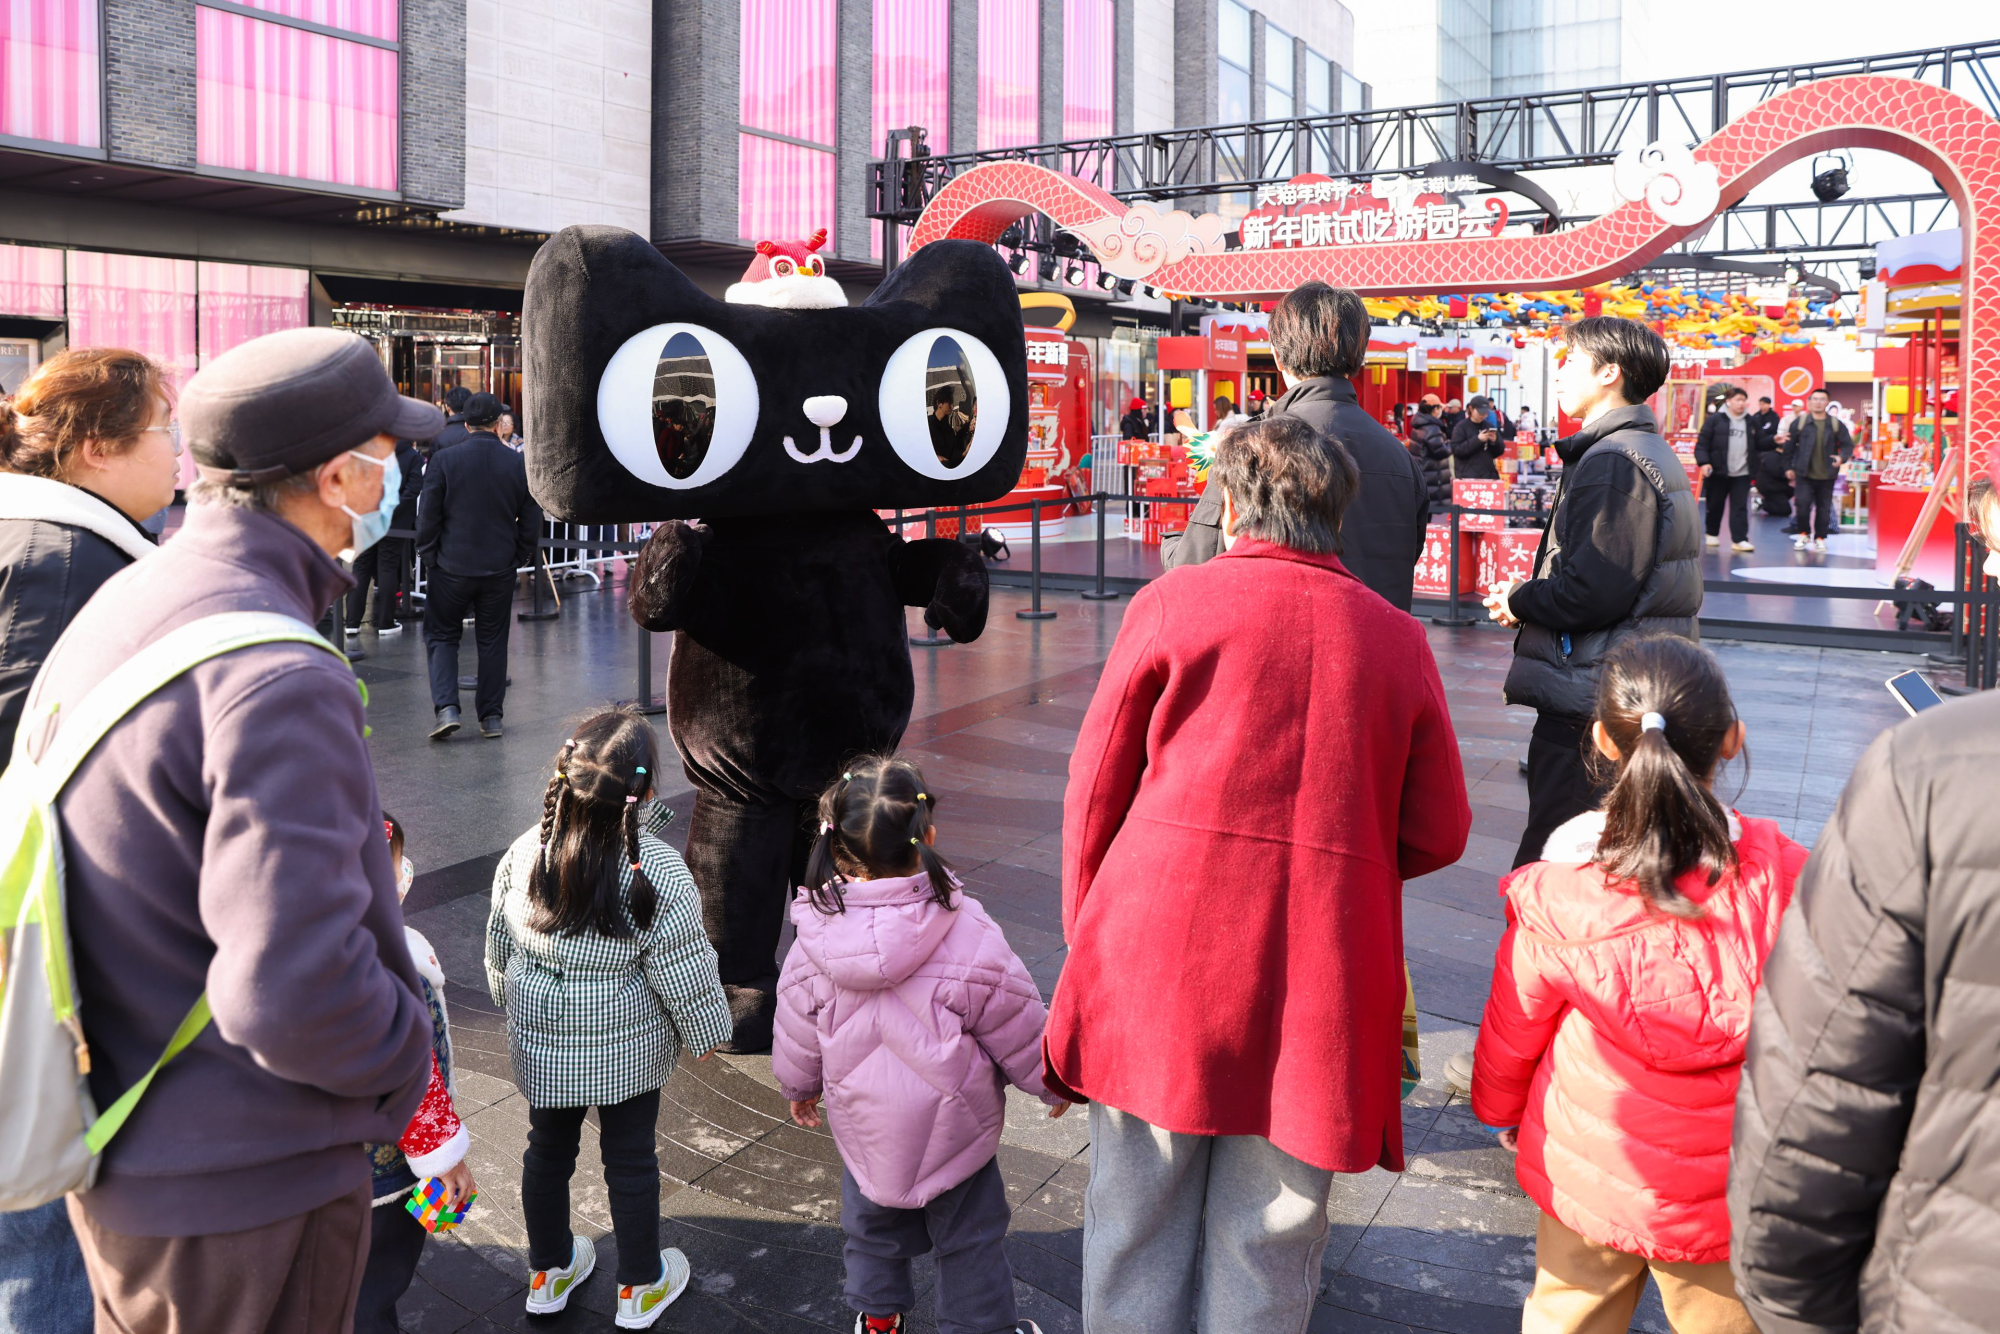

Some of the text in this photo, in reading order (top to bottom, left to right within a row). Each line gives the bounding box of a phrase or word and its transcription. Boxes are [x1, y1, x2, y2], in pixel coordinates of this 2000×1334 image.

[1257, 179, 1348, 207] 天猫年货节
[1411, 175, 1475, 194] 天猫U先
[1243, 204, 1494, 249] 新年味试吃游园会
[1462, 490, 1494, 507] 心想
